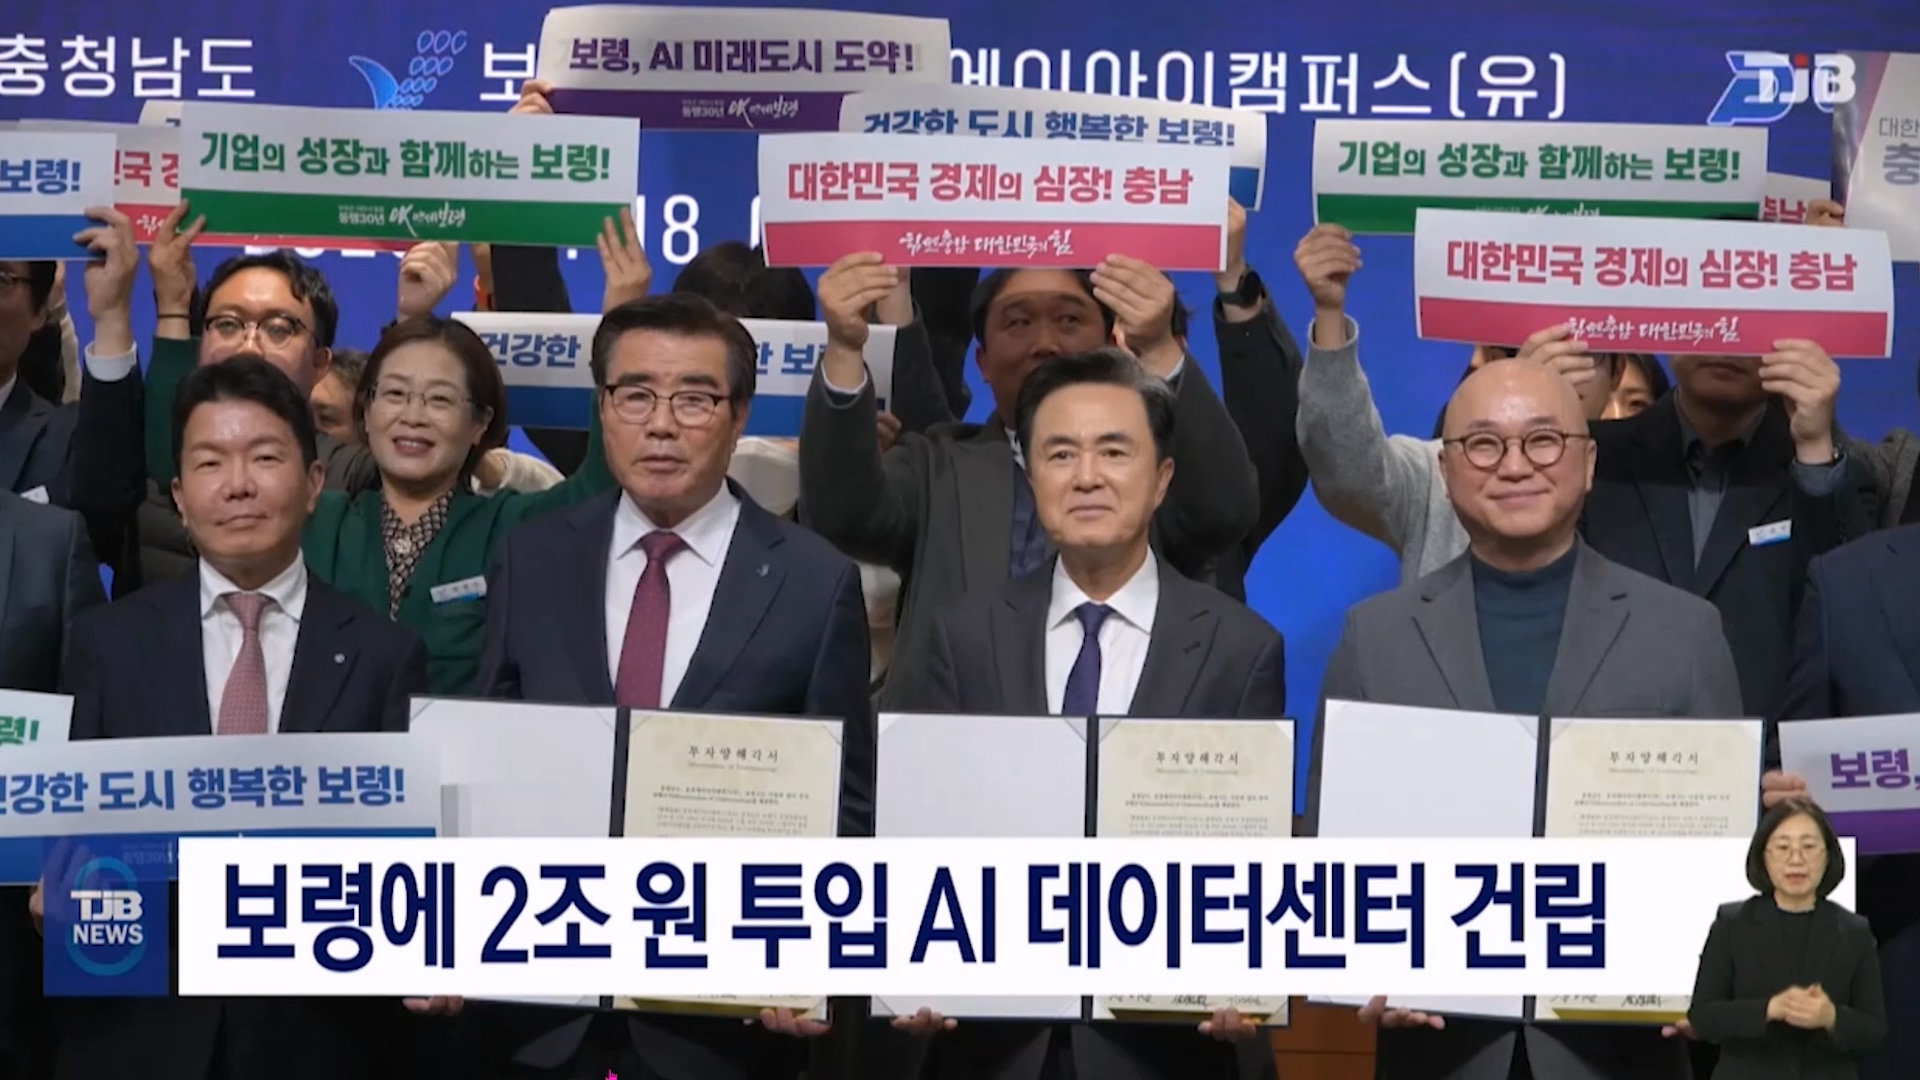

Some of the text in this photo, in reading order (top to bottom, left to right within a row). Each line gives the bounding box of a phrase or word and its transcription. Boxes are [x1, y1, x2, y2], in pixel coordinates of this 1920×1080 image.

[0, 34, 256, 98] 충청남도
[569, 38, 914, 75] 보령, AI 미래도시 도약!
[1157, 118, 1235, 147] 보령!
[0, 159, 81, 195] 보령!
[200, 131, 286, 172] 기업의
[297, 137, 390, 176] 성장과
[400, 139, 520, 181] 함께하는
[531, 143, 610, 183] 보령!
[1338, 141, 1740, 182] 기업의 성장과 함께하는 보령!
[788, 161, 1194, 205] 대한민국 경제의 심장! 충남
[1446, 240, 1858, 292] 대한민국 경제의 심장! 충남
[99, 769, 175, 811] 도시
[188, 765, 307, 809] 행복한
[318, 765, 405, 806] 보령!
